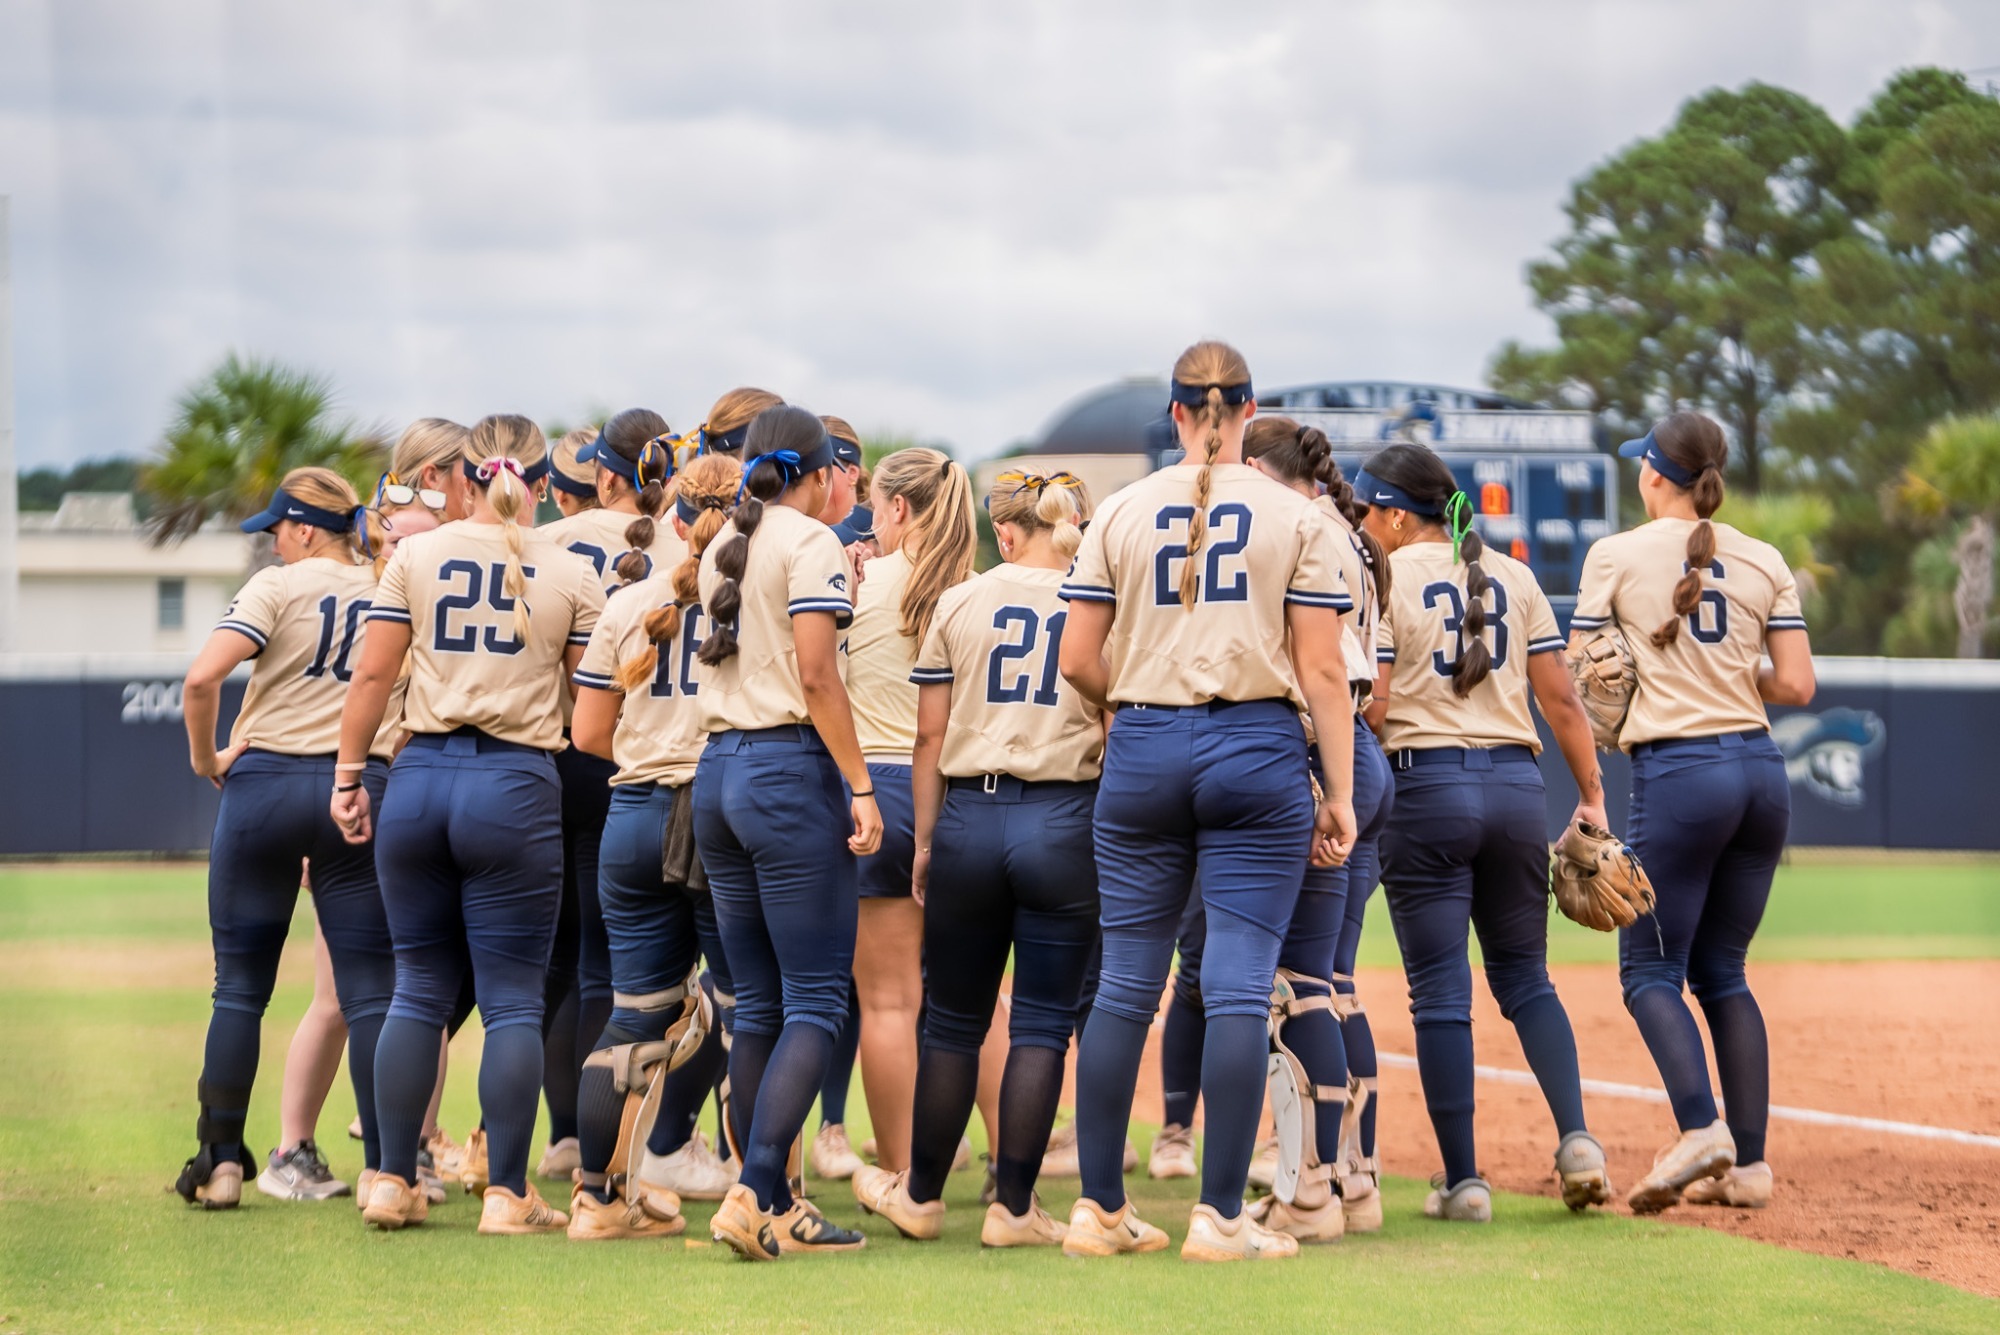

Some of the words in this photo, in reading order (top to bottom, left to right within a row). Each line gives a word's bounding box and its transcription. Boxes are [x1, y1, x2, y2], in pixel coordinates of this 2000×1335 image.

[1155, 502, 1253, 606] 22
[1682, 556, 1728, 643] 6
[434, 559, 536, 655] 25
[986, 605, 1068, 707] 21
[1422, 575, 1508, 677] 38
[121, 680, 184, 723] 200
